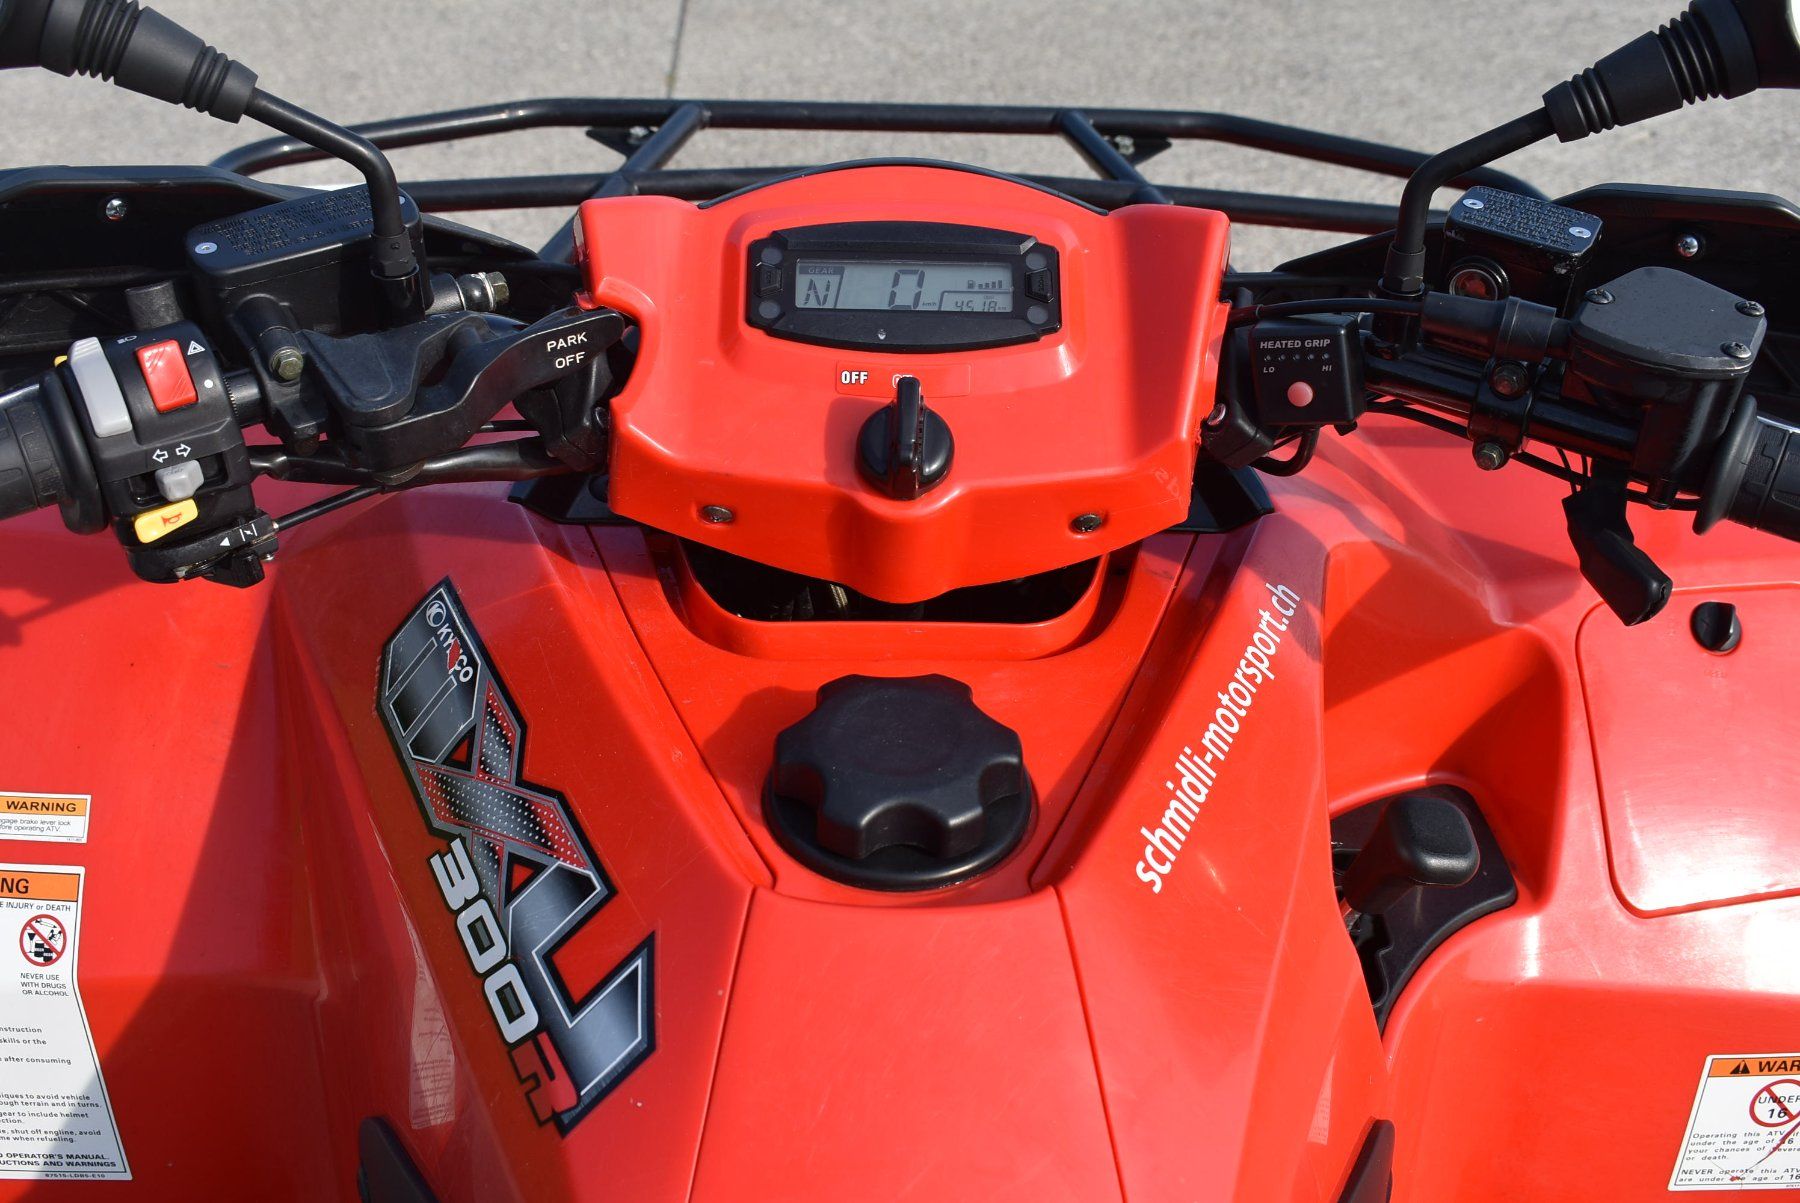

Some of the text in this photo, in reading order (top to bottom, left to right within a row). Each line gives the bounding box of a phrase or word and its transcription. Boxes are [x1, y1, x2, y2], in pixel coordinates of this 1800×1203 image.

[808, 266, 834, 274] GEAR
[803, 278, 831, 306] N
[546, 331, 588, 352] PARK
[1259, 338, 1331, 349] HEATED GRIP
[555, 351, 586, 369] OFF
[1321, 364, 1333, 372] HI
[840, 370, 869, 385] OFF
[437, 623, 473, 682] KYCO
[1135, 582, 1300, 894] schmidli-motorsport.ch
[6, 799, 77, 813] WARNING
[0, 877, 30, 894] NG
[6, 901, 34, 910] INJURY
[45, 903, 71, 912] DEATH
[20, 972, 44, 980] NEVER
[41, 982, 67, 990] DRUGS
[35, 989, 69, 997] ALCOHOL
[4, 1055, 24, 1063] after
[26, 1057, 72, 1065] consuming
[1768, 1108, 1787, 1119] 16
[1692, 1132, 1737, 1140] Operating
[6, 1152, 64, 1160] OPERATOR'S
